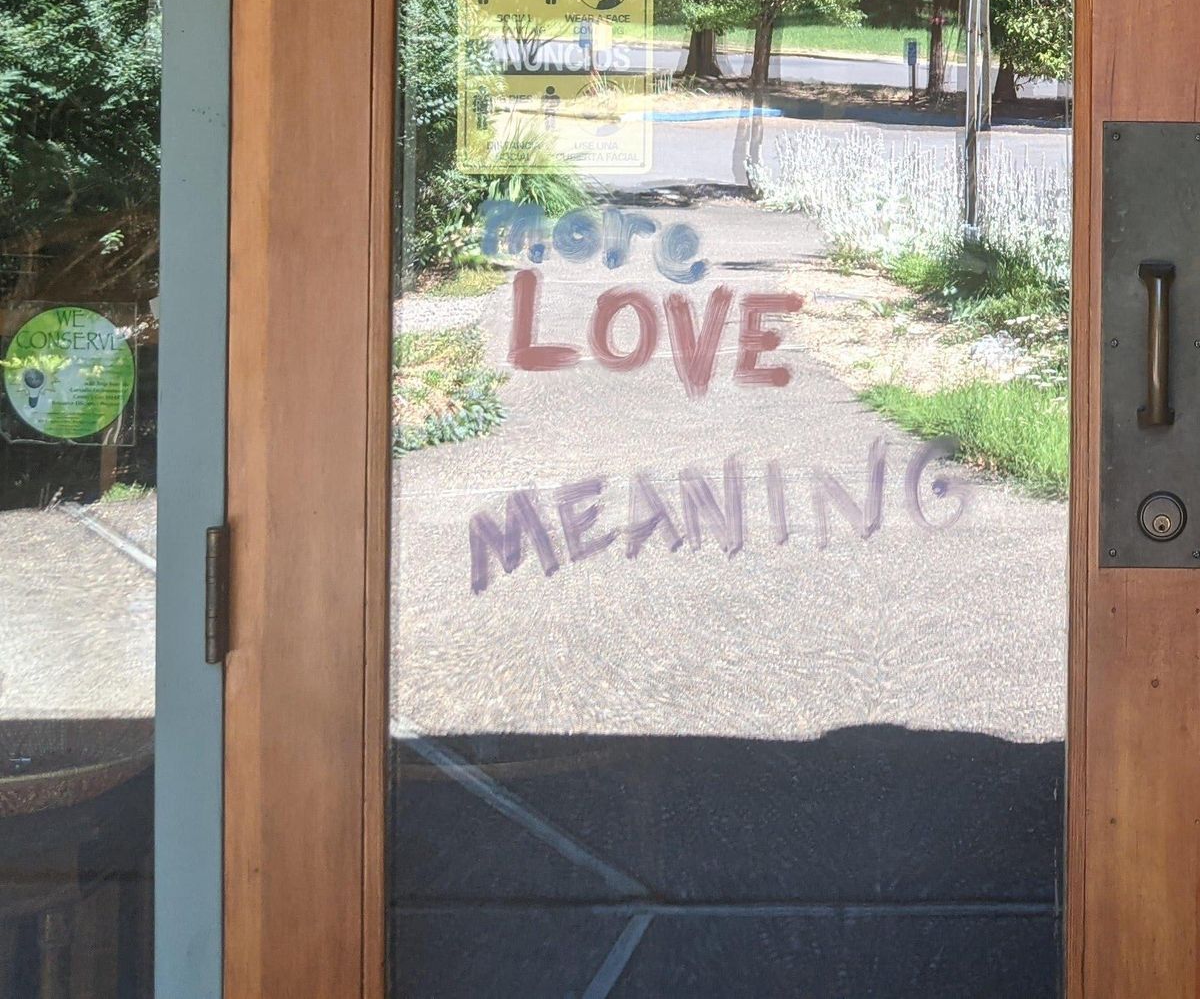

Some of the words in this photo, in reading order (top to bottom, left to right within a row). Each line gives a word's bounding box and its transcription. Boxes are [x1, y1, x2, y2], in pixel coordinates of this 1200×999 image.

[564, 14, 594, 23] WEAR
[606, 14, 631, 23] FACE
[57, 309, 85, 328] WE
[16, 330, 125, 351] CONSERVE
[507, 268, 805, 398] LOVE
[466, 435, 972, 595] MEANING
